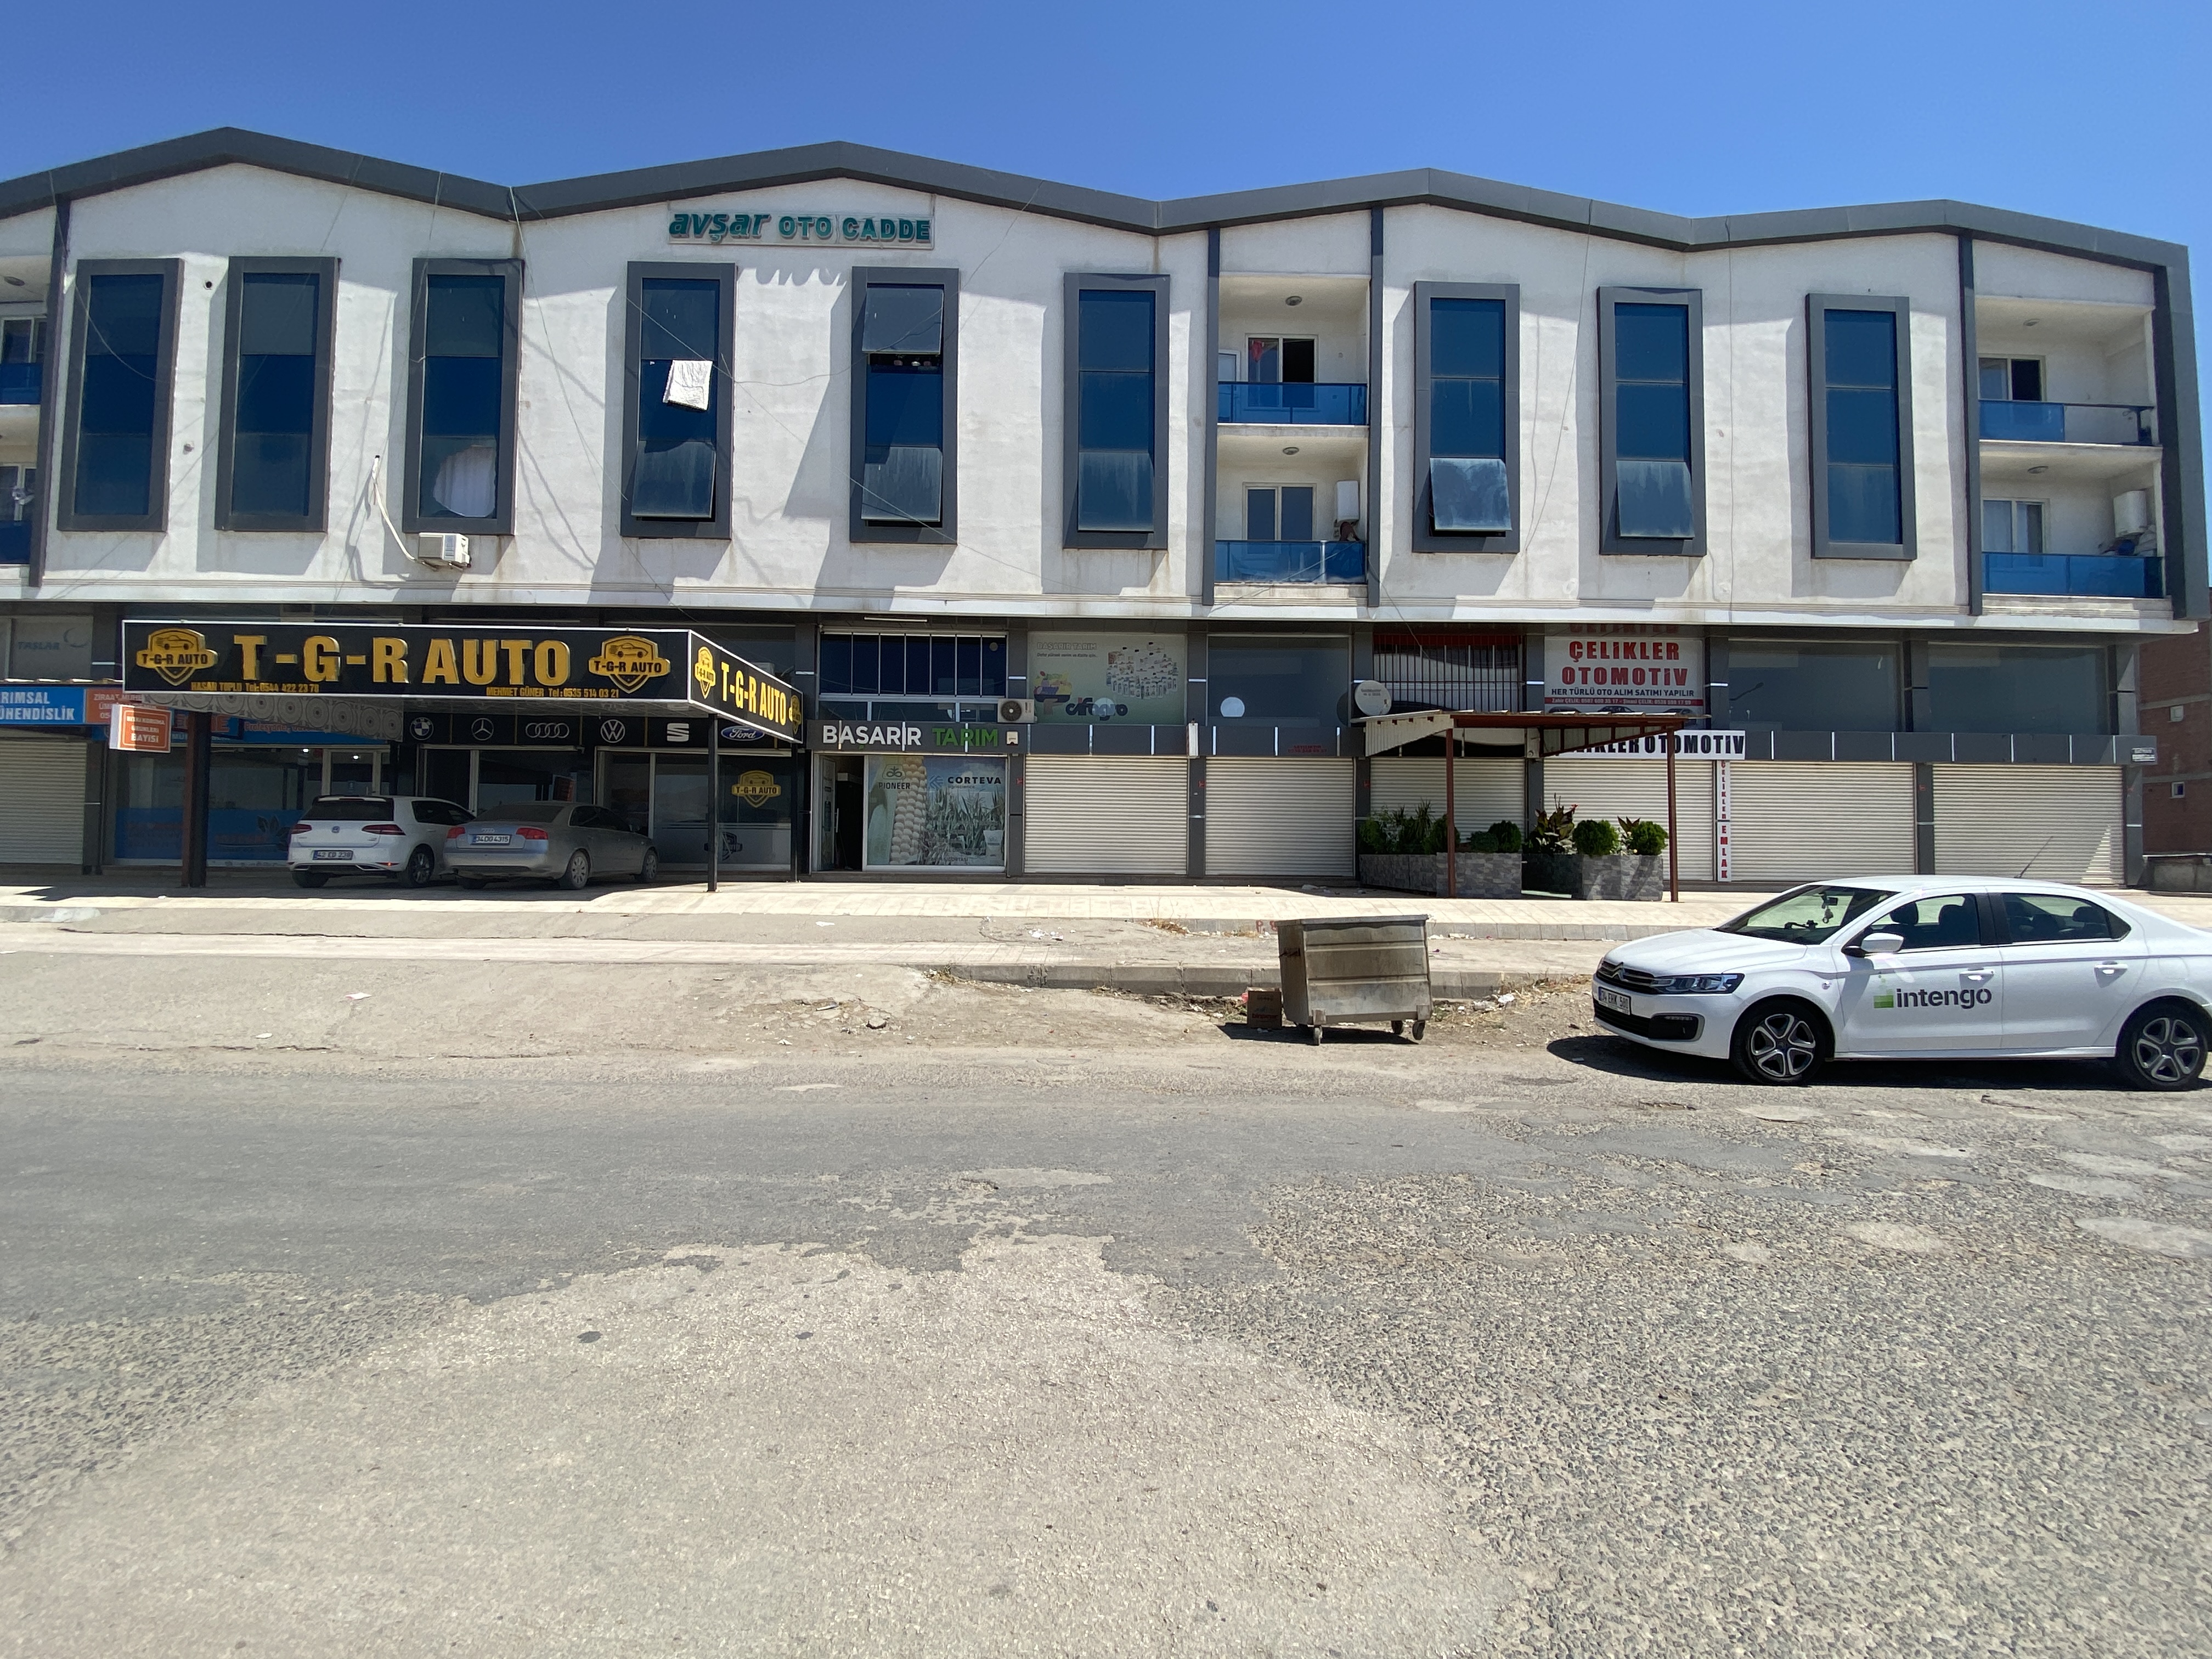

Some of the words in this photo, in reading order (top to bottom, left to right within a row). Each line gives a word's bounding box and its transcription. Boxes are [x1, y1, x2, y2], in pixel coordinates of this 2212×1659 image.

[778, 216, 833, 239] OTO
[842, 217, 931, 241] CADDE
[178, 653, 208, 664] AUTO
[422, 639, 571, 685] AUTO
[631, 662, 662, 673] AUTO
[486, 687, 518, 697] MEHMET
[584, 689, 597, 698] 514
[599, 689, 609, 698] 03
[611, 689, 619, 698] 21
[759, 682, 786, 726] AUTO
[823, 725, 922, 749] BAŞARIR
[933, 728, 998, 747] TARIM
[947, 776, 1002, 785] CORTEVA
[1897, 988, 1992, 1009] intengo
